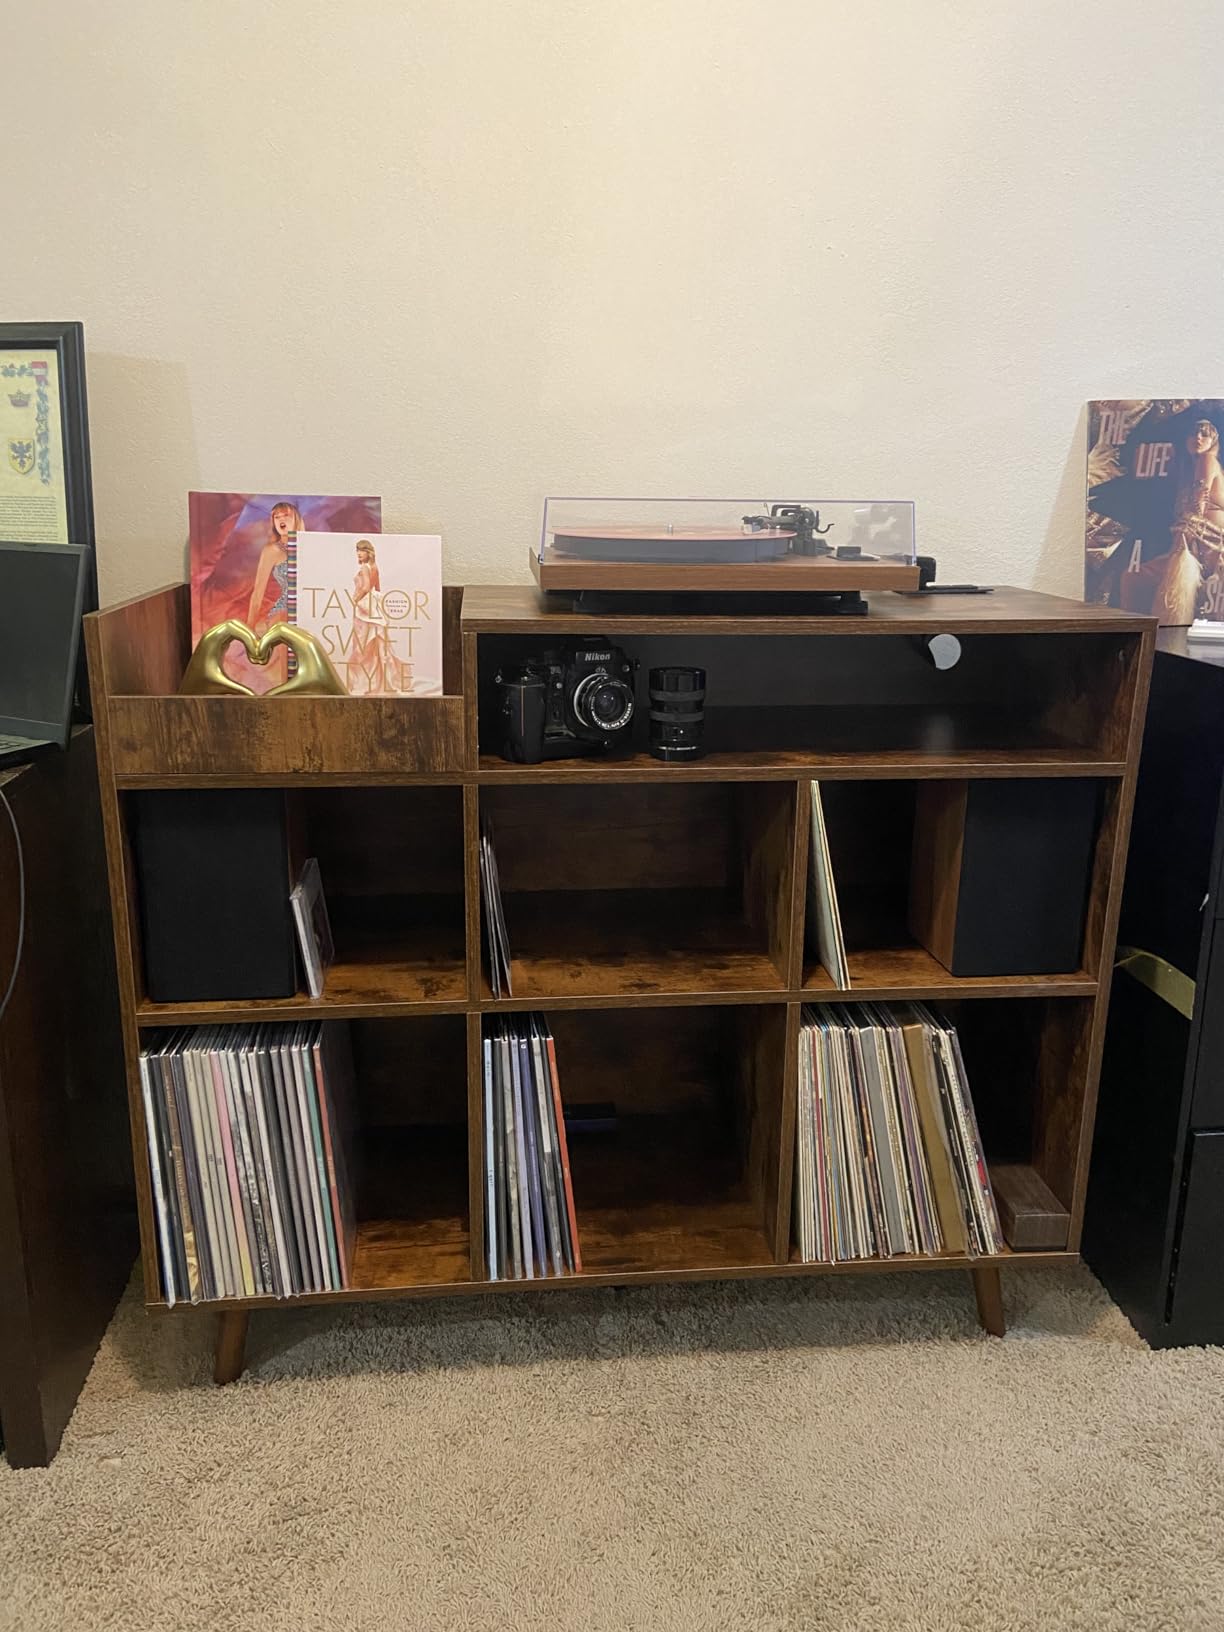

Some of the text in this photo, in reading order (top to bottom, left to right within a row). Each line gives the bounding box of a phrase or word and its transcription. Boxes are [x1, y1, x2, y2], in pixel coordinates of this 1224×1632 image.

[1098, 410, 1129, 445] THE
[1135, 442, 1172, 477] LIFE
[1127, 539, 1142, 573] A
[302, 587, 431, 620] TAYLOR
[321, 624, 422, 657] SWIFT
[585, 652, 611, 661] Nikon
[333, 661, 415, 692] TYLE
